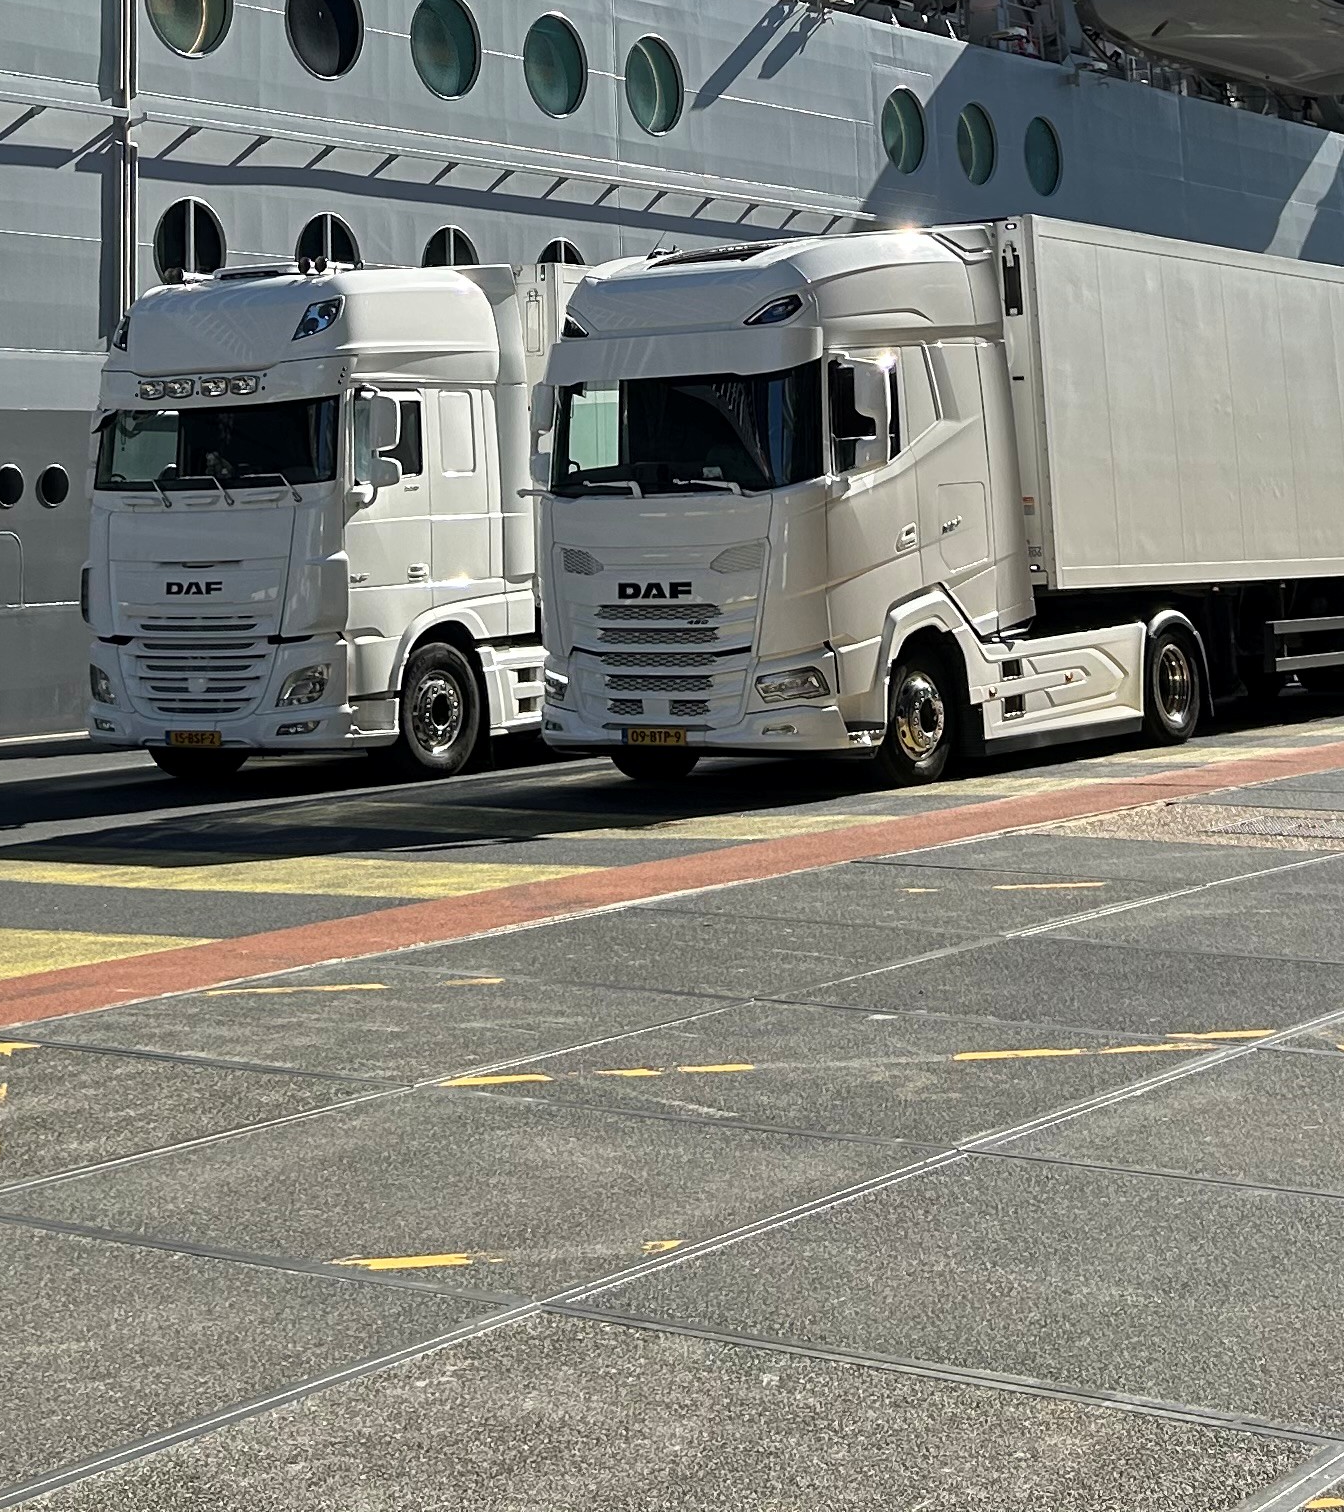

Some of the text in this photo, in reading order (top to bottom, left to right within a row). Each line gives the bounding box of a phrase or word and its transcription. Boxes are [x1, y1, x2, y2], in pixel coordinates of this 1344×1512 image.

[165, 581, 223, 595] DAF
[618, 581, 692, 599] DAF
[631, 730, 682, 743] 09-BTP-9
